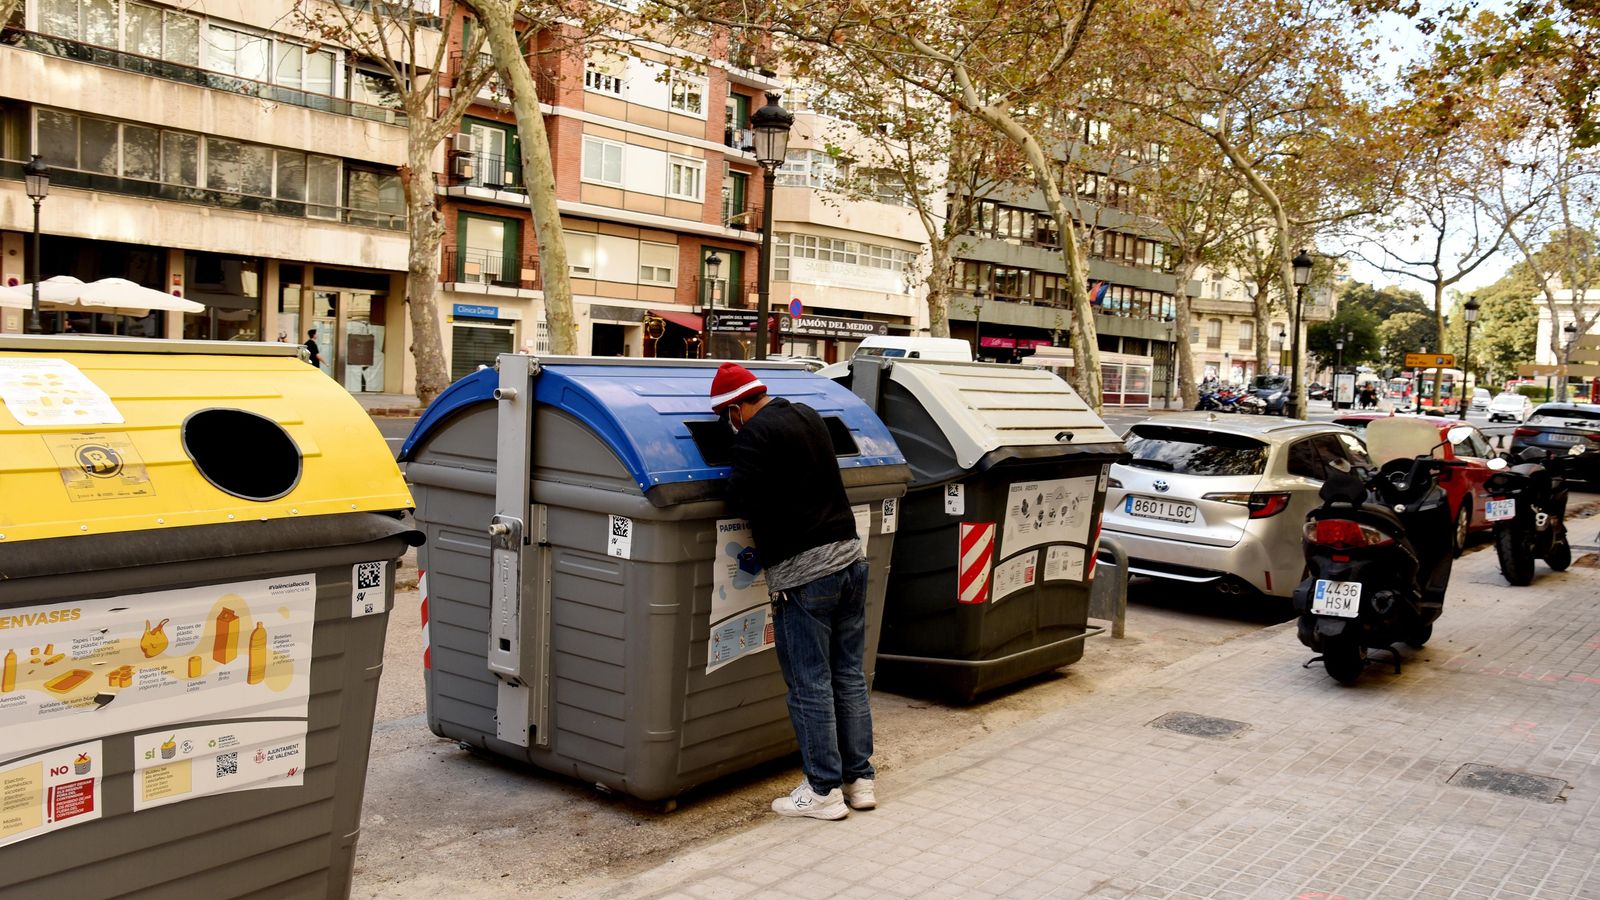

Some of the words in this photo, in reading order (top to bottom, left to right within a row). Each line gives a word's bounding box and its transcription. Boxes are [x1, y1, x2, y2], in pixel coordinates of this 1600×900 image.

[477, 307, 495, 315] Dental
[797, 318, 827, 328] JAMÓN
[828, 321, 845, 329] DEL
[846, 322, 874, 331] MEDIO
[1135, 500, 1164, 514] 8601
[1168, 504, 1192, 518] LGC
[720, 523, 741, 532] PAPER
[1325, 582, 1358, 597] 4436
[1325, 596, 1351, 610] HSM
[0, 608, 81, 629] ENVASES
[268, 743, 299, 755] AJUNTAMENT
[50, 765, 69, 776] NO
